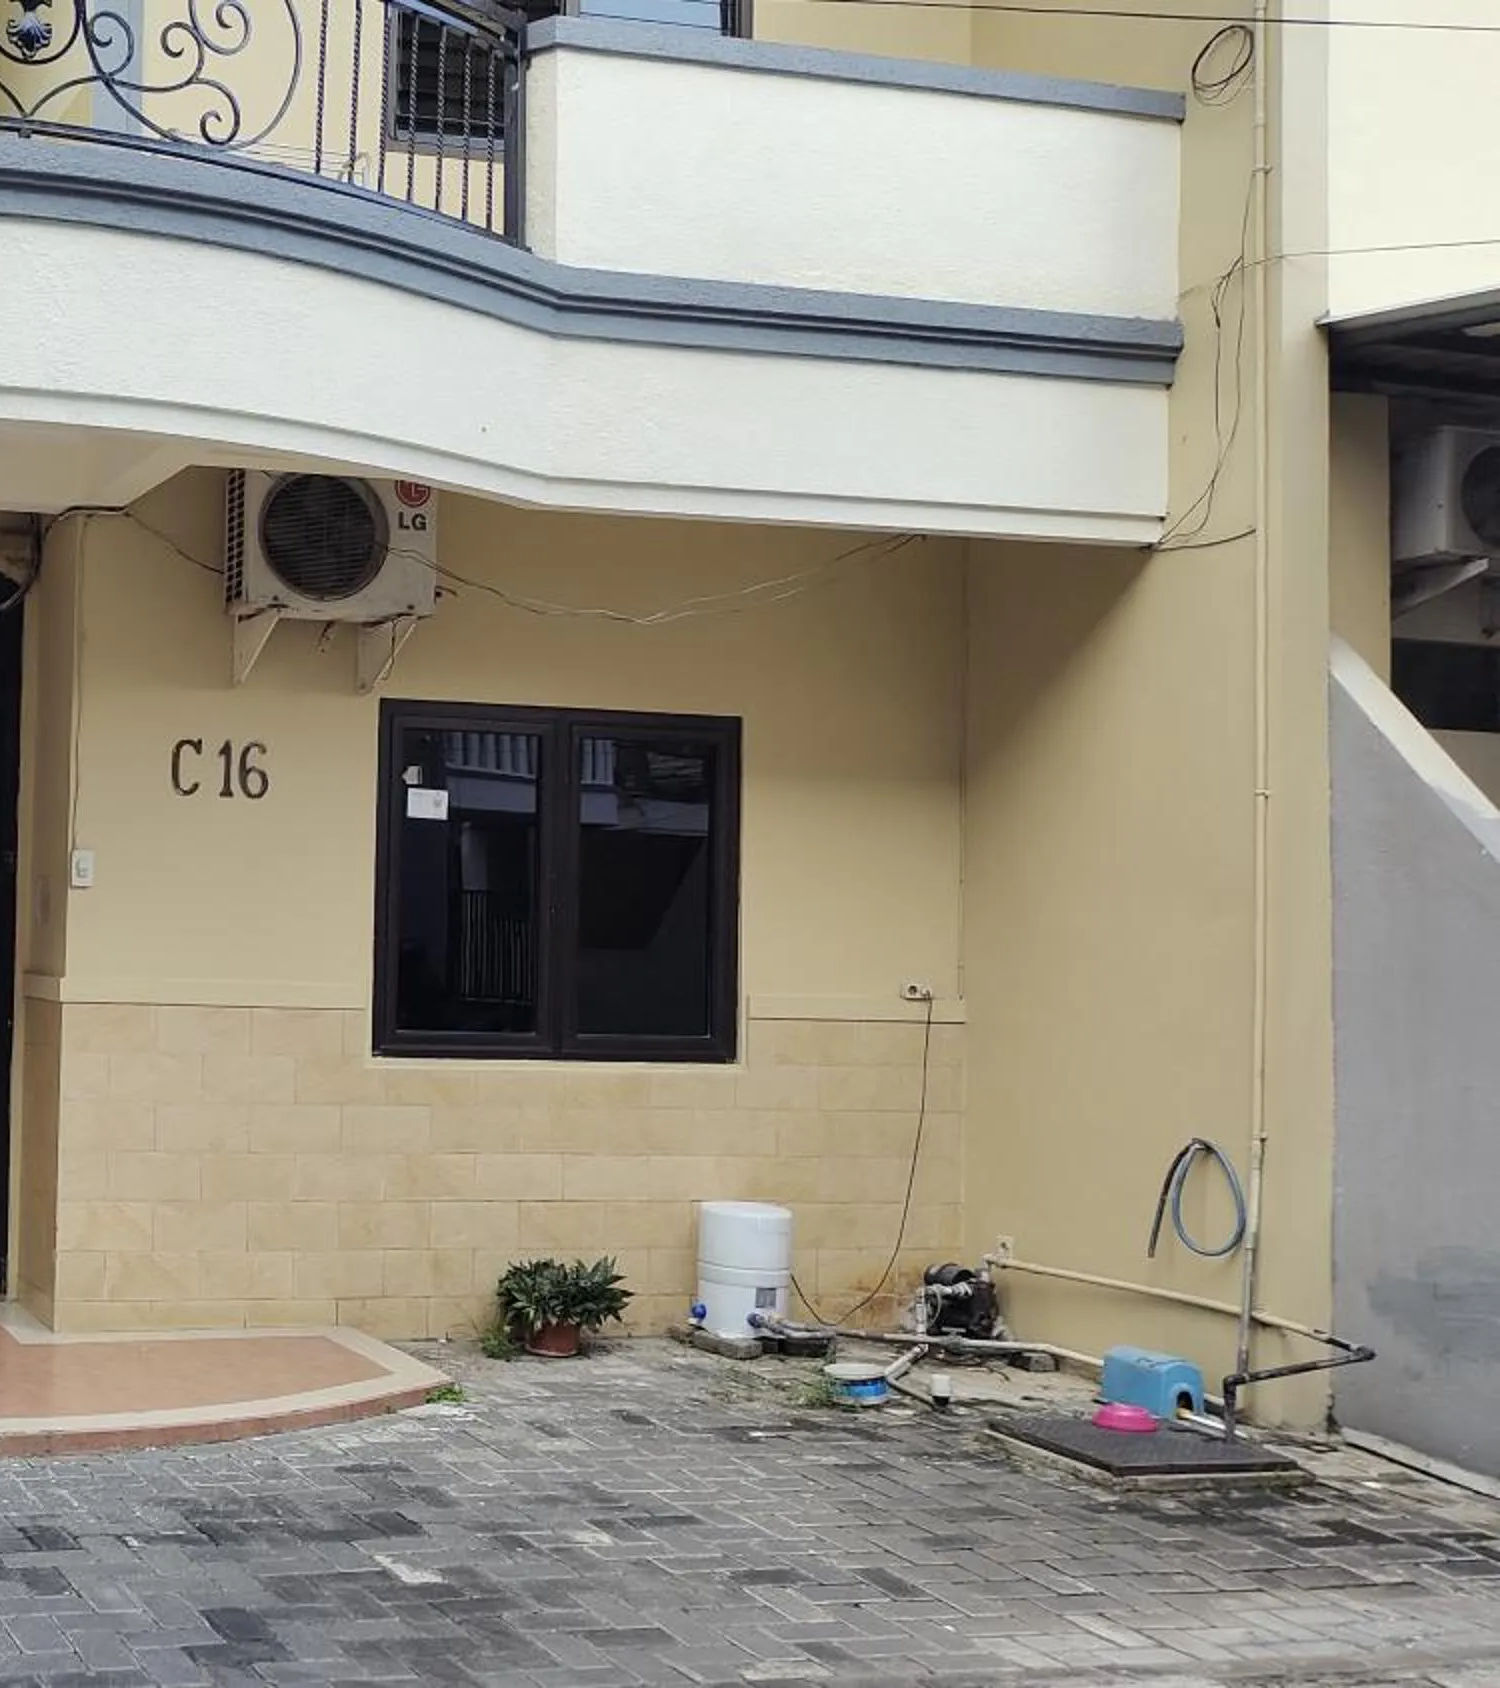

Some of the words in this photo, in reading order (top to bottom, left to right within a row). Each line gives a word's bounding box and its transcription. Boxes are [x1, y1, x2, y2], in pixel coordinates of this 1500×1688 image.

[398, 511, 427, 531] LG
[171, 738, 203, 797] C
[218, 740, 270, 800] 16
